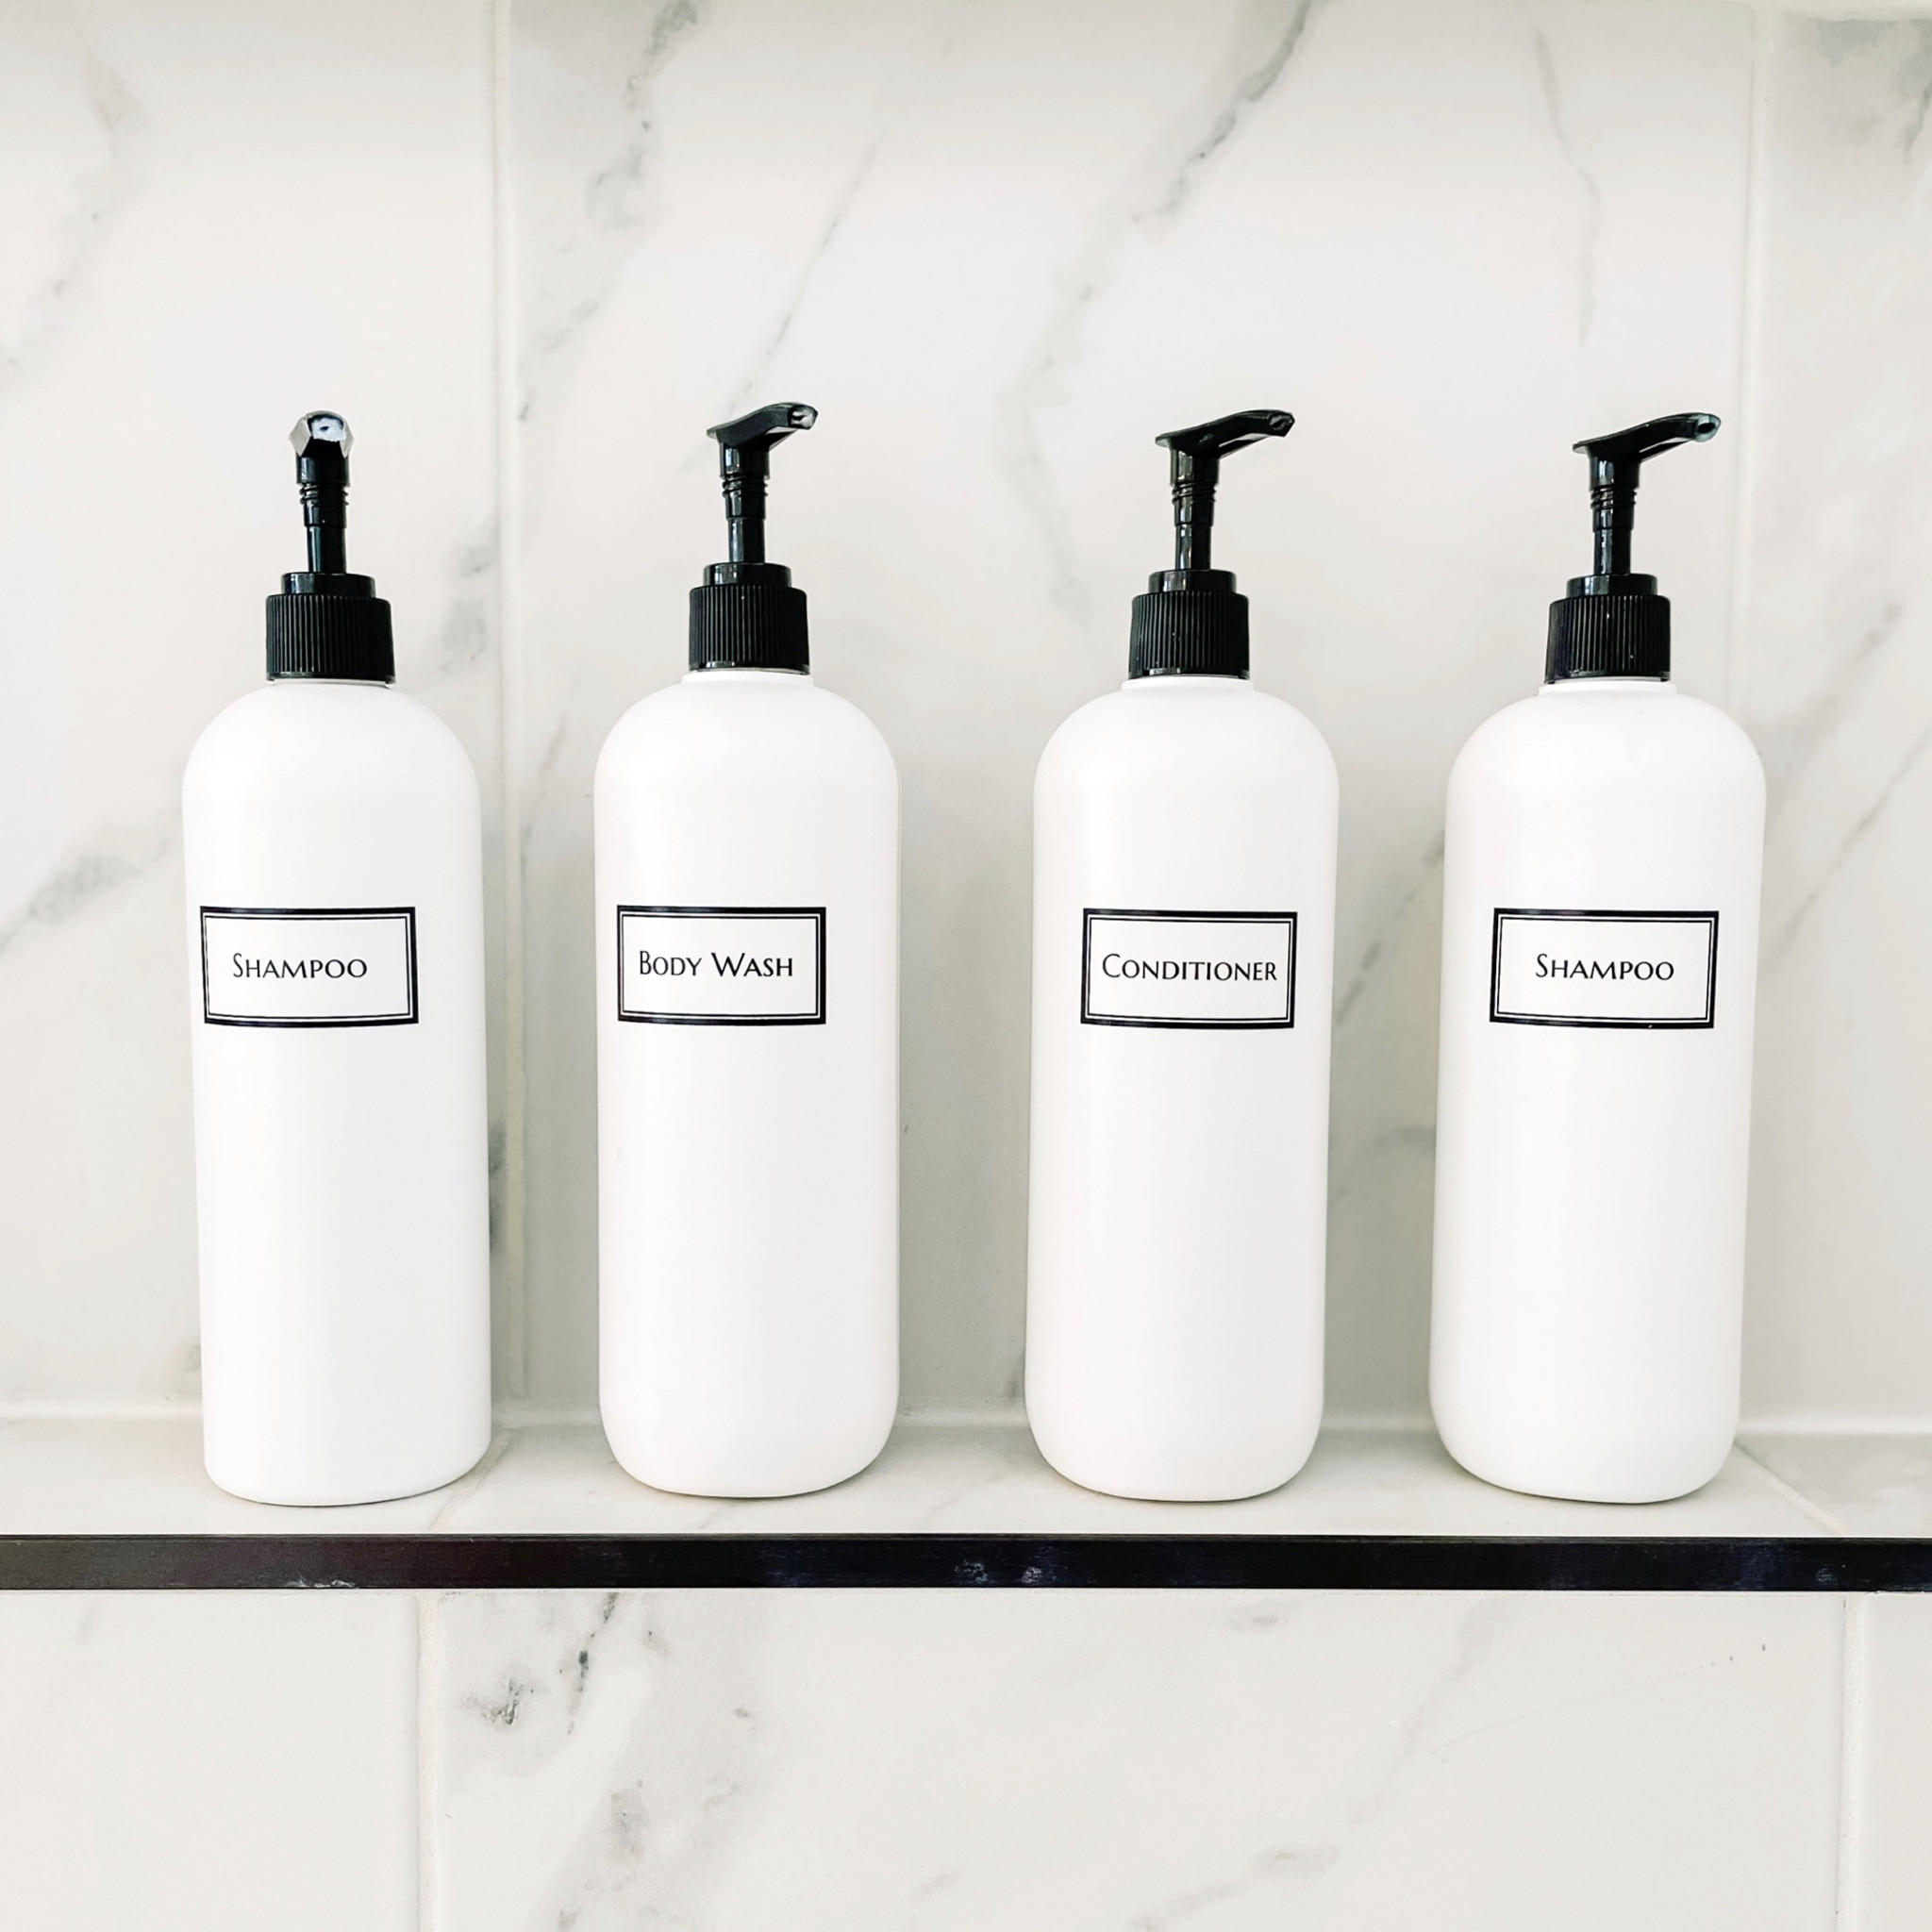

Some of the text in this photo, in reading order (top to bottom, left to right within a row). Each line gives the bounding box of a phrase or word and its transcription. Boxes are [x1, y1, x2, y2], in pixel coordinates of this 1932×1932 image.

[232, 952, 368, 979] SHAMPOO
[639, 950, 793, 977] BODY WASH
[1102, 953, 1278, 981] CONDITIONER
[1535, 953, 1674, 981] SHAMPOO
